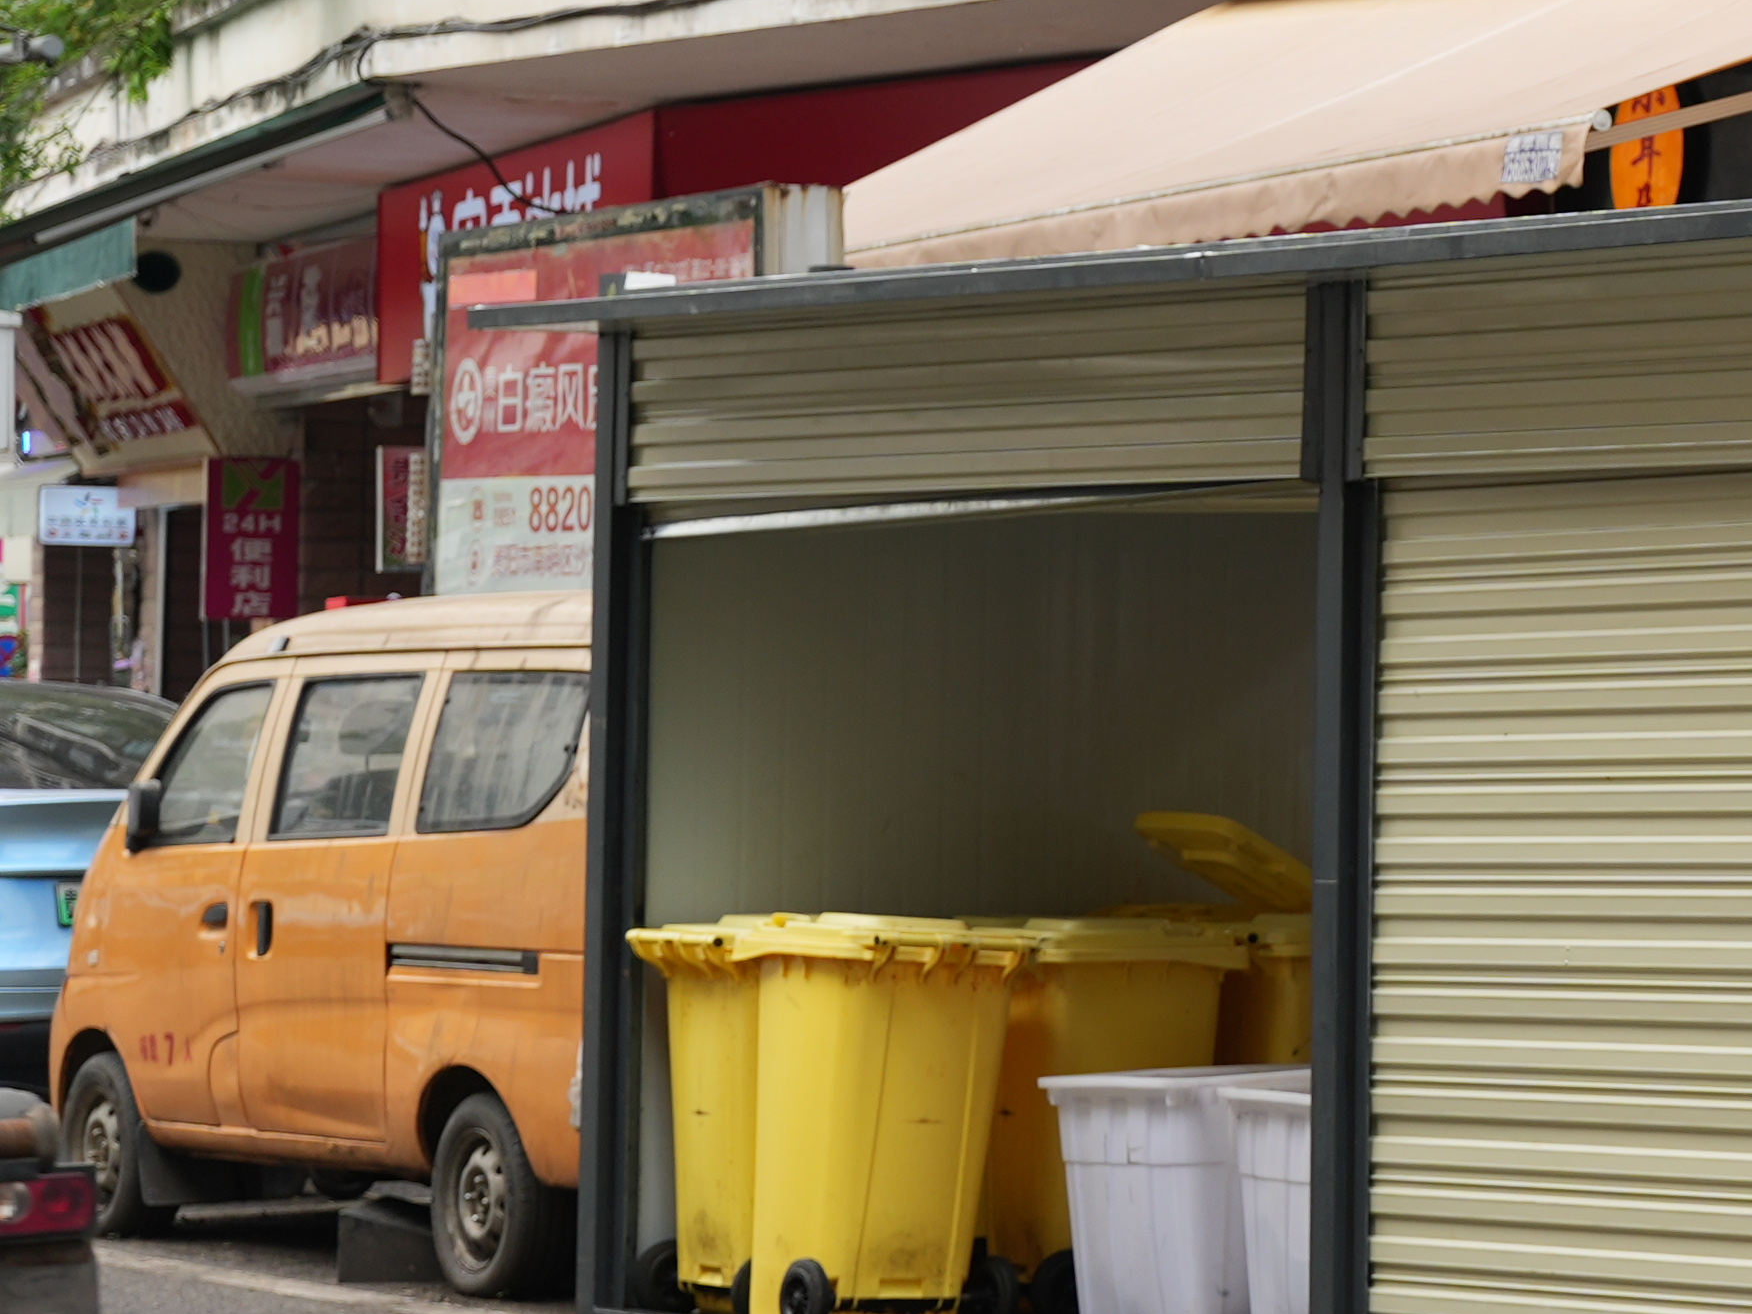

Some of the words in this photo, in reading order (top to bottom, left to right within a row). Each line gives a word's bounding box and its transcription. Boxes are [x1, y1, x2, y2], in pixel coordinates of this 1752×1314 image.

[222, 512, 283, 535] 24H
[529, 487, 592, 532] 8820
[230, 538, 273, 617] 便利店
